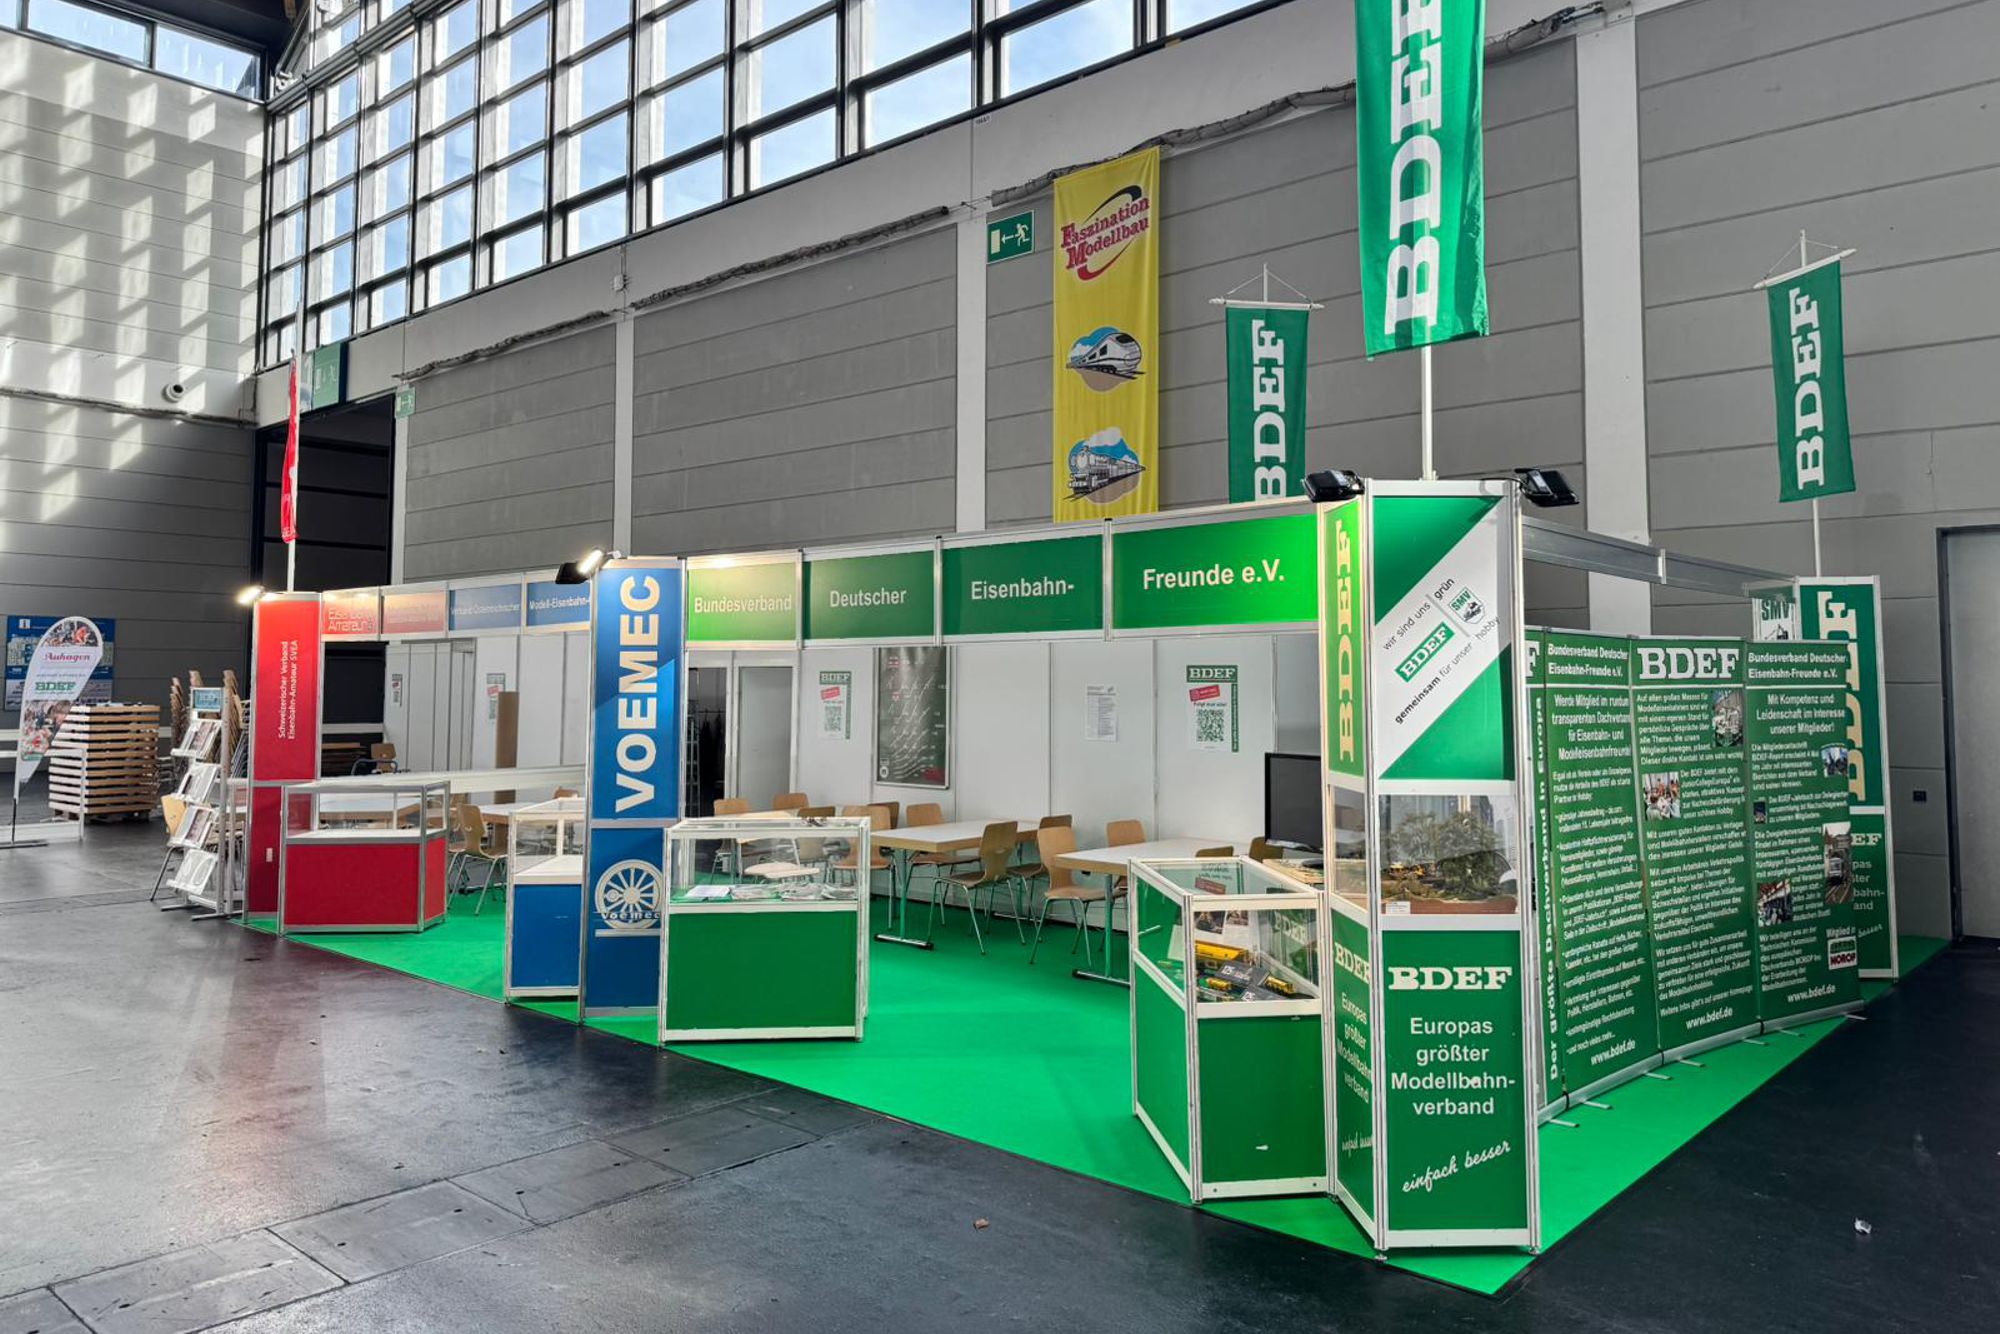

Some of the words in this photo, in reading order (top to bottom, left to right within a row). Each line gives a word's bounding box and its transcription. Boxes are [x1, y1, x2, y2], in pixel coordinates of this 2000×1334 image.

[1061, 197, 1150, 249] Faszination
[1066, 217, 1150, 270] Modellbau
[1789, 287, 1825, 491] BDEF
[1252, 319, 1287, 501] BDEF
[694, 594, 792, 614] Bundesverband
[829, 587, 907, 608] Deutscher
[971, 576, 1075, 600] Eisenbahn-
[1143, 563, 1235, 591] Freunde
[1241, 558, 1286, 583] e.V.
[1451, 590, 1471, 611] SMV
[1383, 635, 1398, 651] wir
[1396, 617, 1416, 638] sind
[1414, 601, 1432, 619] uns
[1434, 578, 1456, 600] grün
[1761, 600, 1791, 621] SMV
[1336, 519, 1354, 763] BDEF
[1399, 626, 1448, 679] BDEF
[1548, 643, 1599, 658] Bundesverband
[280, 640, 289, 674] Verband
[1395, 676, 1441, 725] gemeinsam
[1440, 664, 1453, 677] für
[1452, 641, 1474, 665] unser
[1475, 615, 1501, 640] hobby
[1548, 662, 1611, 677] Eisenbahn-Freunde
[1637, 647, 1740, 680] BDEF
[1748, 652, 1808, 664] Bundesverband
[1809, 653, 1847, 664] Deutscher
[35, 681, 77, 691] BDEF
[1190, 667, 1235, 679] BDEF
[1748, 668, 1821, 680] Eisenbahn-Freunde
[1823, 668, 1838, 679] e.V.
[288, 663, 297, 740] Eisenbahn-Amateur
[615, 574, 661, 814] VOEMEC
[1768, 694, 1778, 705] Mit
[1780, 693, 1819, 708] Kompetenz
[1820, 694, 1835, 704] und
[1756, 708, 1802, 721] Leidenschaft
[1815, 707, 1846, 718] Interesse
[1770, 723, 1797, 735] unserer
[1536, 697, 1545, 774] Europa
[1540, 781, 1546, 800] in
[1540, 808, 1553, 953] Dachverband
[1335, 941, 1371, 985] BDEF
[1388, 966, 1513, 991] BDEF
[1787, 984, 1836, 1003] www.bdef.de
[1341, 991, 1367, 1025] Europas
[1546, 959, 1557, 1034] größte
[1410, 1016, 1494, 1038] Europas
[1686, 1006, 1734, 1029] www.bdef.de
[1416, 1044, 1490, 1066] größter
[1550, 1039, 1558, 1081] Der
[1591, 1039, 1636, 1066] www.bdef.de
[1391, 1071, 1516, 1090] Modellbahn-
[1413, 1097, 1495, 1115] verband
[1402, 1154, 1458, 1193] einfach
[1464, 1139, 1511, 1168] besser
